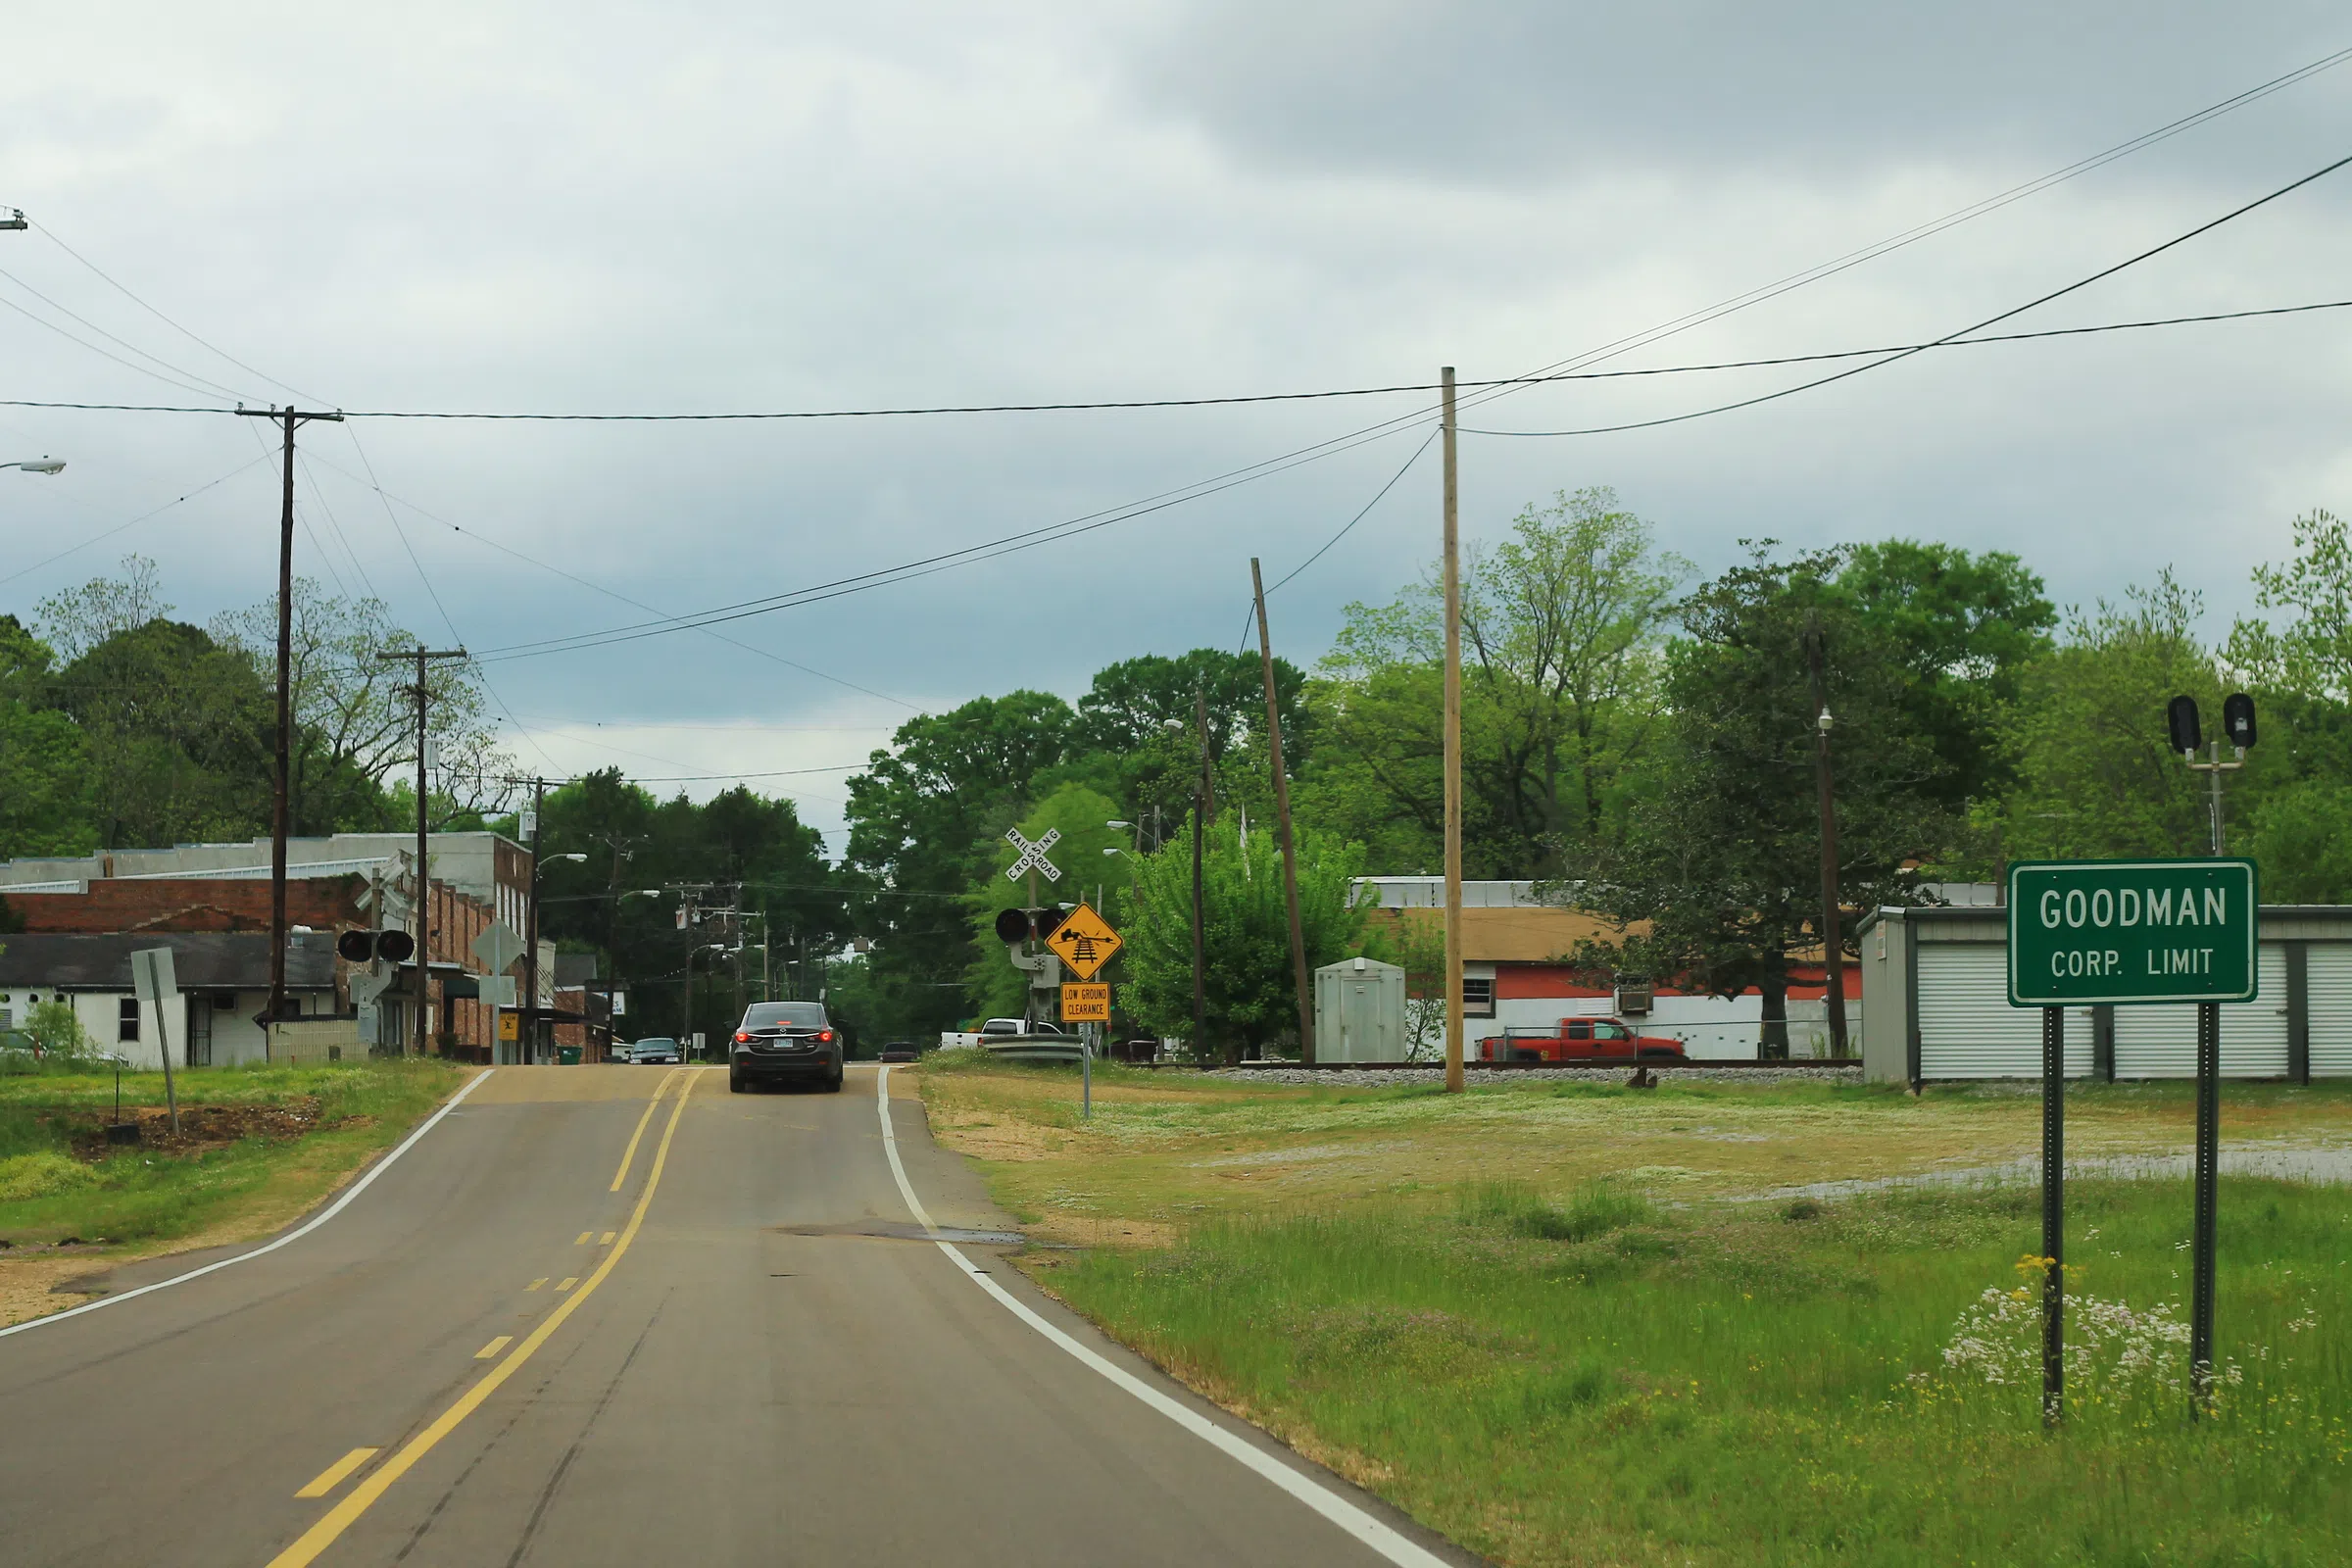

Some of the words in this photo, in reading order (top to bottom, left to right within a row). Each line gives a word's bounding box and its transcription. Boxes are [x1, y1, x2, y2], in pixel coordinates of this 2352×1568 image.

[1007, 830, 1058, 879] CROSSING
[1007, 830, 1058, 880] RAILROAD
[2039, 887, 2227, 929] GOODMAN
[2051, 950, 2123, 977] CORP.
[2147, 948, 2213, 975] LIMIT
[1064, 988, 1079, 1000] LOW
[1081, 988, 1107, 1000] GROUND
[1067, 1003, 1104, 1015] CLEARANCE
